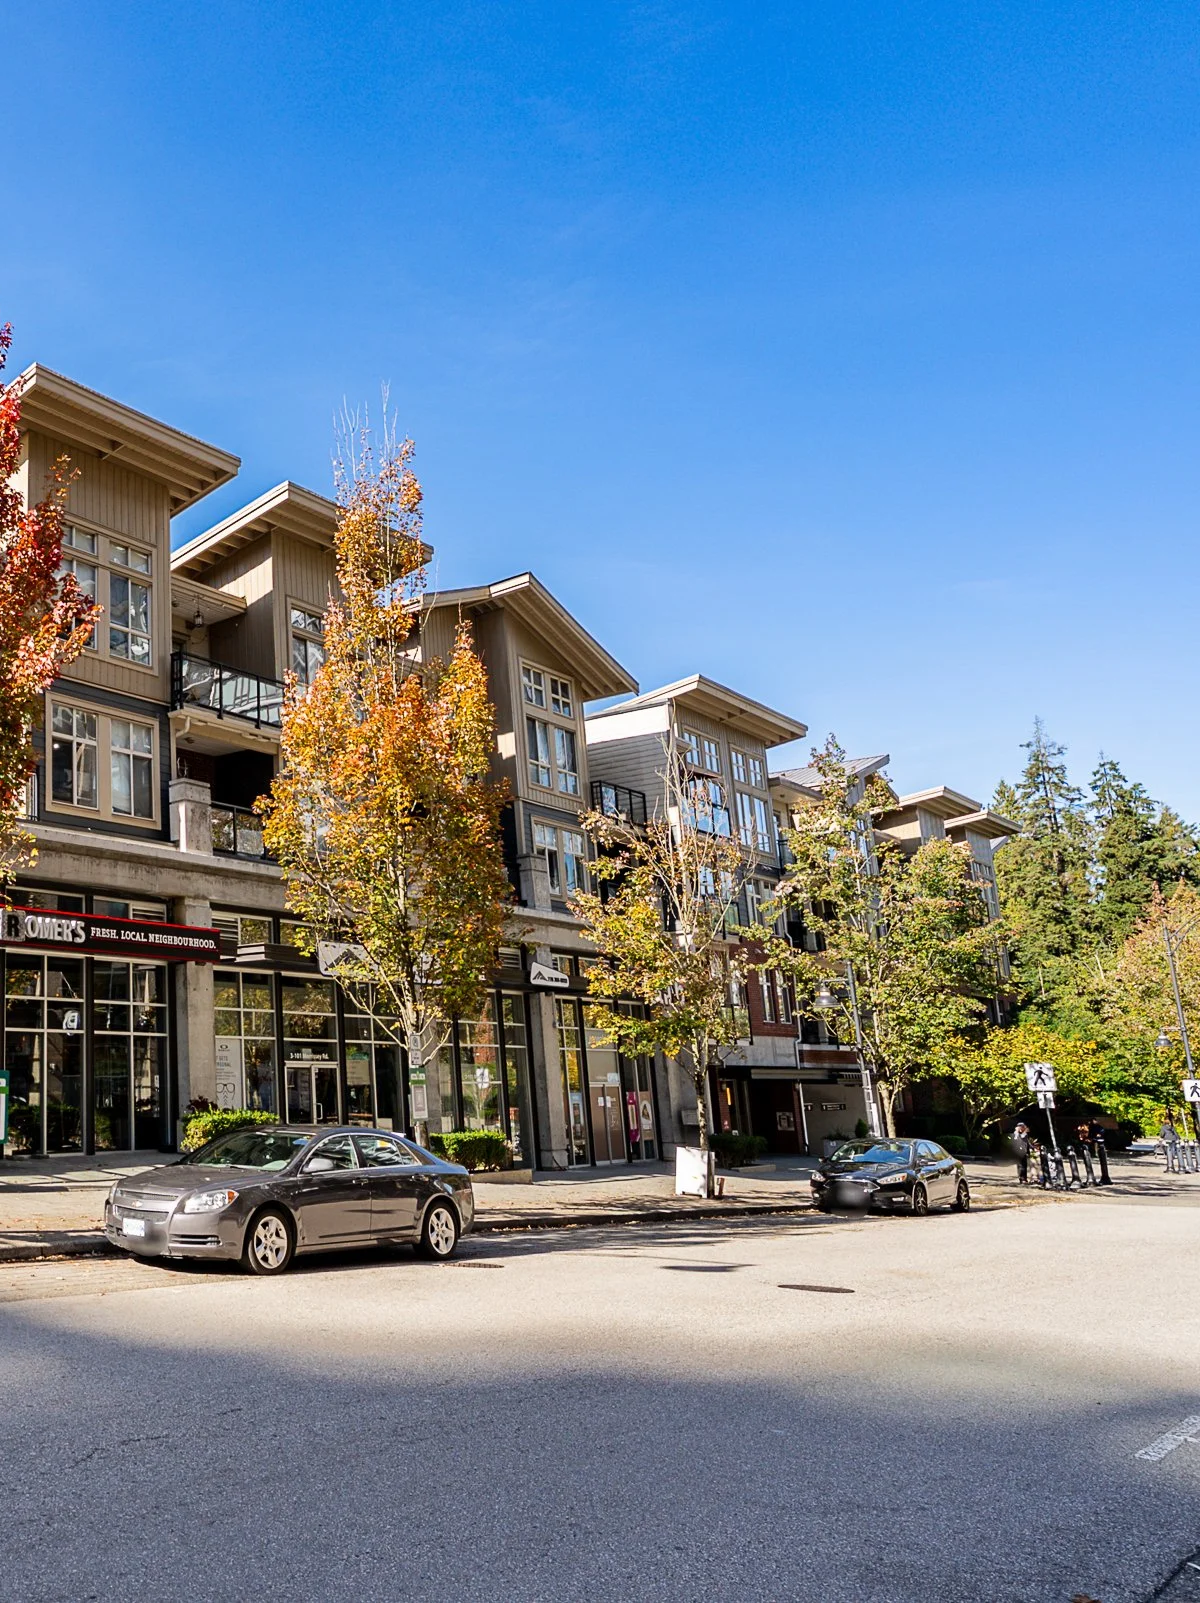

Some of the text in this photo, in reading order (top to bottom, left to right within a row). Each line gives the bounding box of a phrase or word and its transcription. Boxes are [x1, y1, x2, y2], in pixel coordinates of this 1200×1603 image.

[3, 909, 217, 949] ROMER'S FRESH. LOCAL. NEIGHBOURHOOD.
